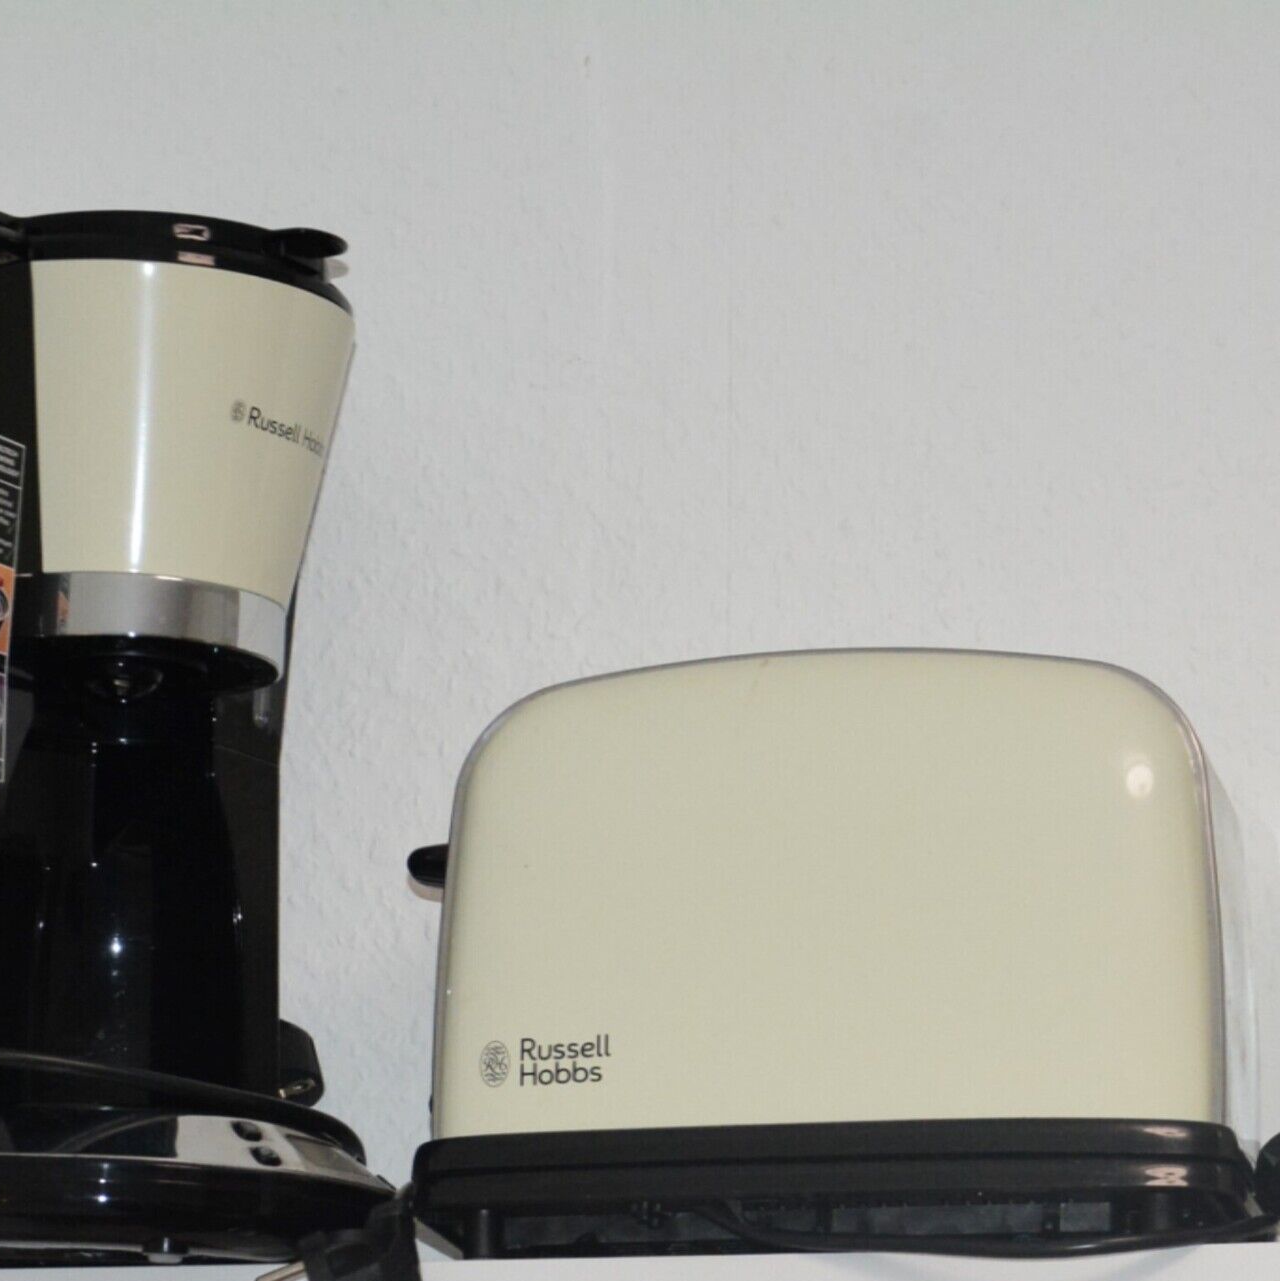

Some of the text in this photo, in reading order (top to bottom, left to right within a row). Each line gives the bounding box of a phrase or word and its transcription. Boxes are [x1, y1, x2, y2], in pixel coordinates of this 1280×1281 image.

[247, 405, 302, 444] Russell
[519, 1033, 611, 1061] Russell
[519, 1061, 602, 1087] Hobbs
